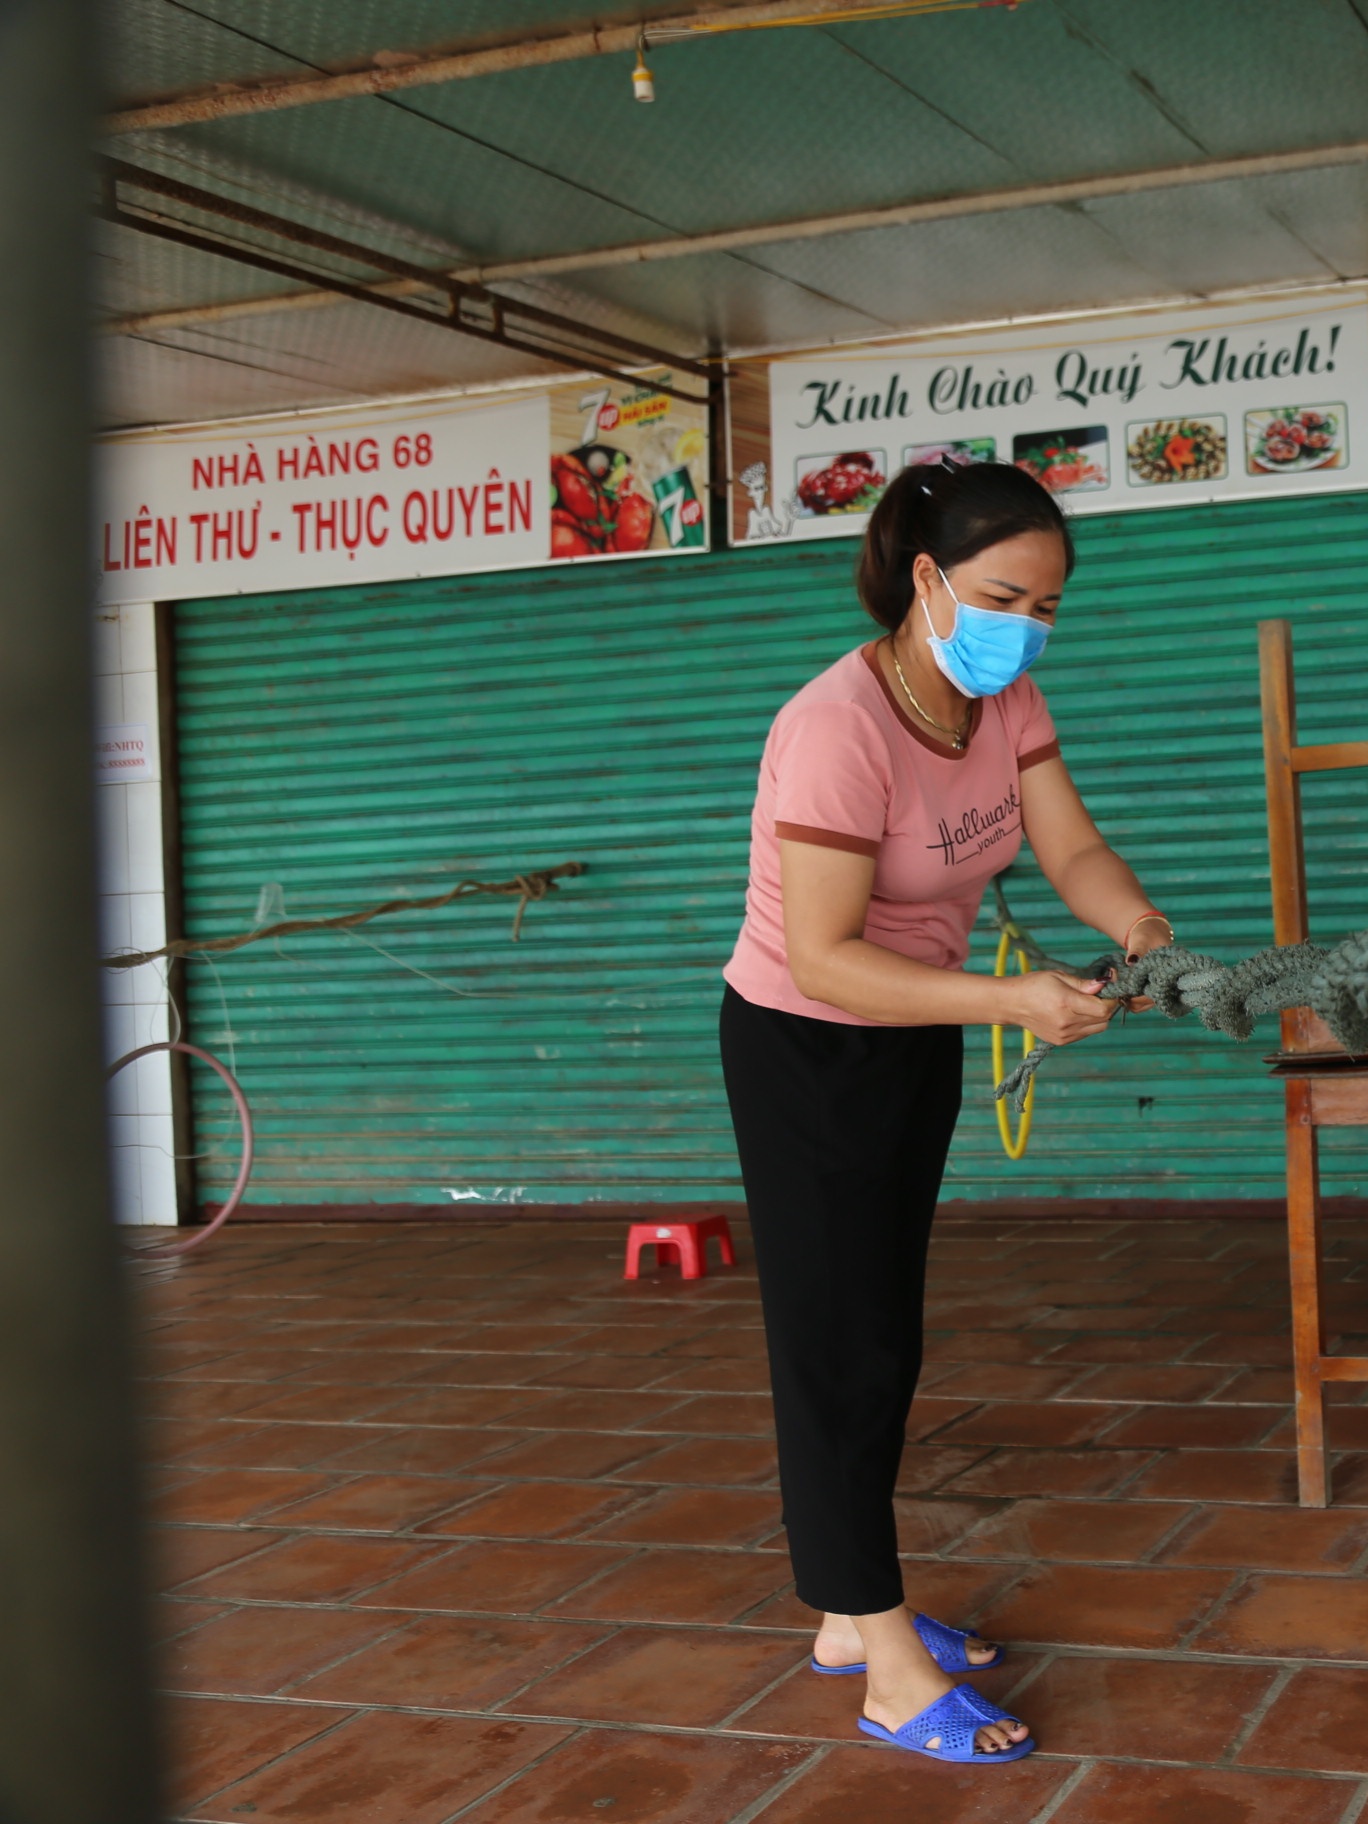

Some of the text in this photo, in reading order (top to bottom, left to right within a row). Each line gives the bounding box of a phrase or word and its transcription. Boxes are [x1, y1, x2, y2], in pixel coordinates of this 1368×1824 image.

[928, 364, 1040, 416] Chào
[1055, 349, 1147, 409] Quý
[1159, 324, 1342, 390] Khách!
[192, 432, 434, 491] NHÀ HÀNG 68
[103, 505, 178, 572] LIÊN
[189, 500, 262, 563] THƯ
[292, 494, 390, 561] THỤC
[403, 467, 532, 544] QUYÊN
[977, 827, 1007, 856] youth
